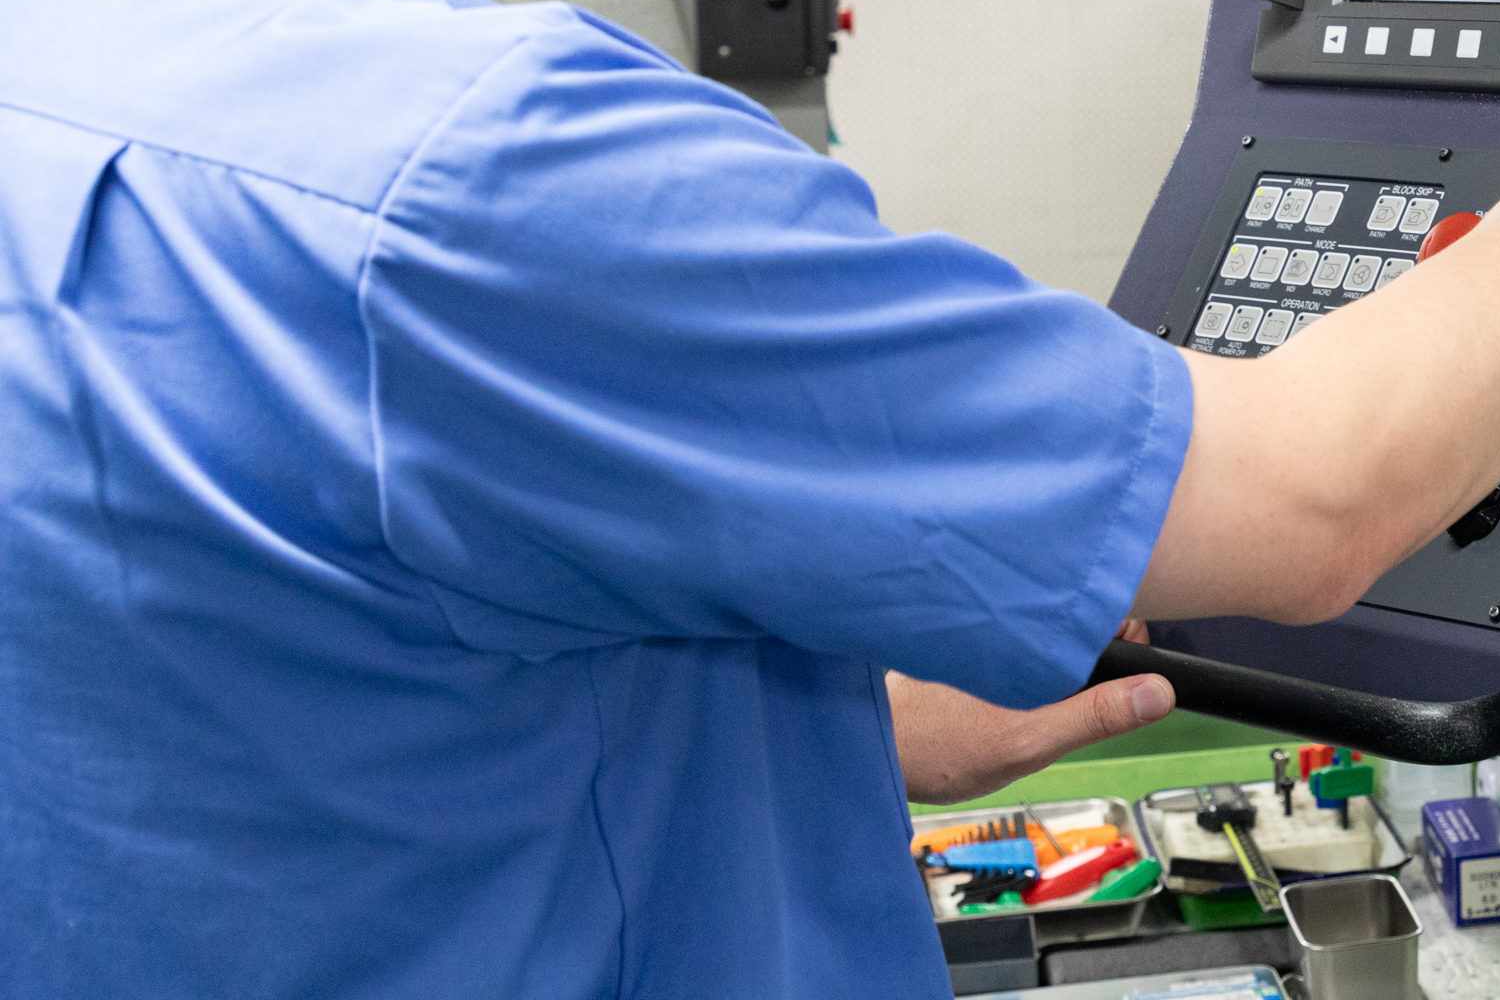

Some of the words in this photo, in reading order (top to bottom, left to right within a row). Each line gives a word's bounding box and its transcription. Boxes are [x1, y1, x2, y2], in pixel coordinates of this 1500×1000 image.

[1294, 178, 1313, 187] PATH
[1392, 186, 1415, 195] BLOCK
[1416, 188, 1433, 196] SKIP
[1401, 234, 1419, 242] PATH2
[1315, 240, 1336, 249] MODE
[1281, 299, 1320, 310] OPERATION
